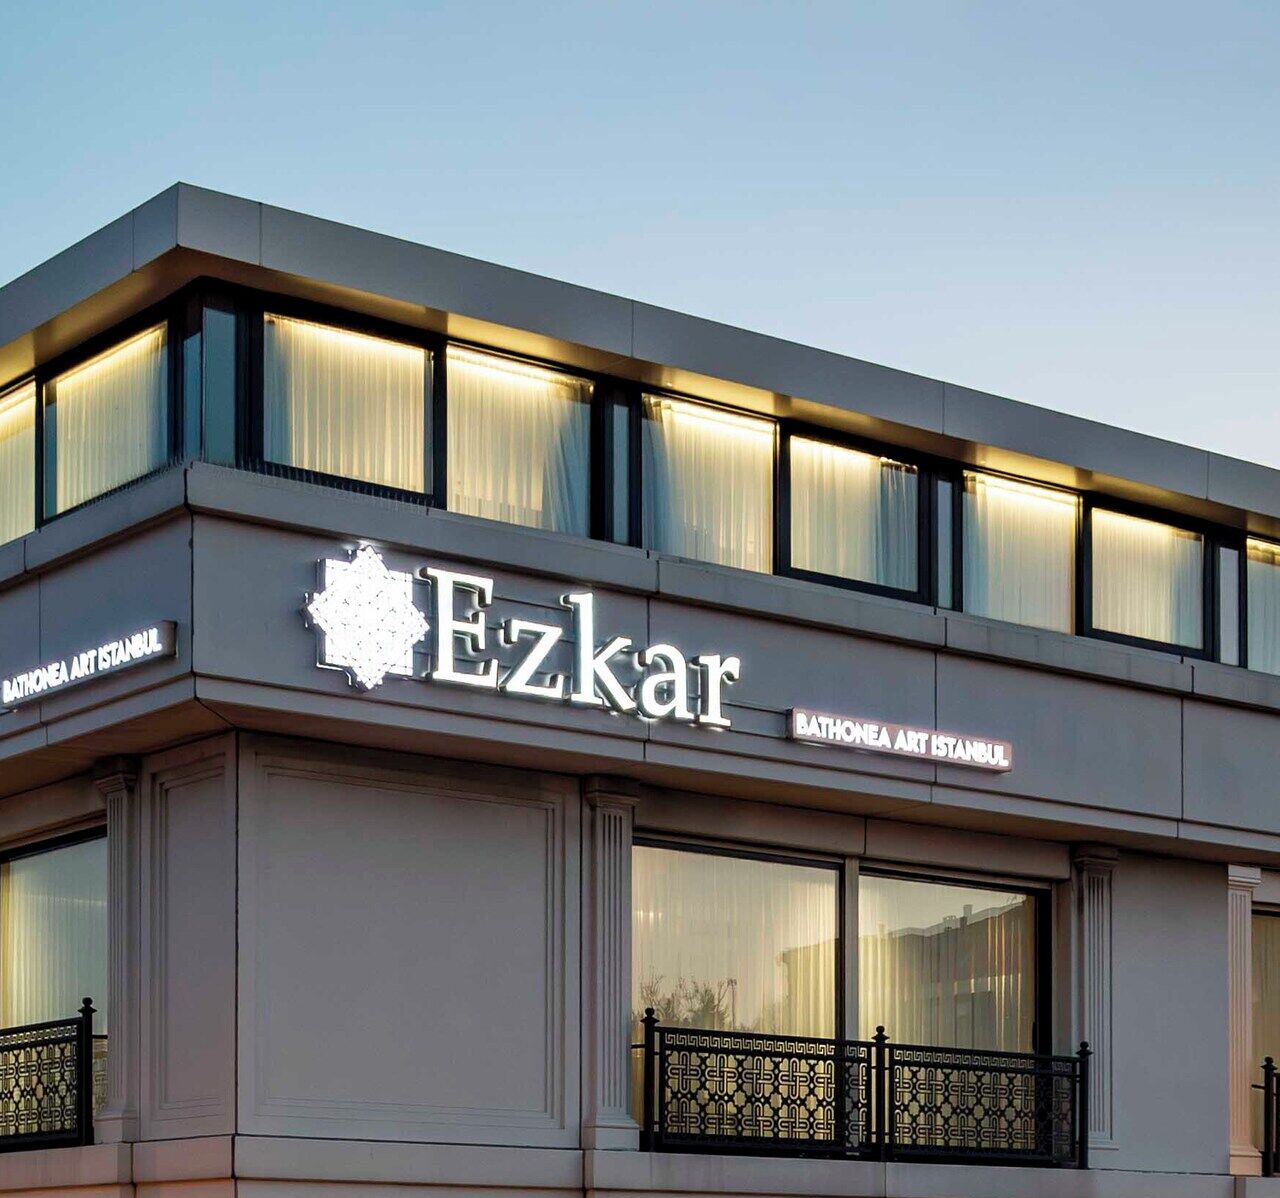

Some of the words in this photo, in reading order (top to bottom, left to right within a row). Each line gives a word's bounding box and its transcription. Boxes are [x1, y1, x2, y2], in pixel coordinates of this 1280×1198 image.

[2, 660, 69, 703] BATHONEA
[70, 649, 97, 681] ART
[98, 627, 162, 671] ISTANBUL
[422, 566, 741, 728] Ezkar
[796, 712, 892, 749] BATHONEA
[893, 728, 929, 755] ART
[930, 734, 1009, 767] ISTANBUL
